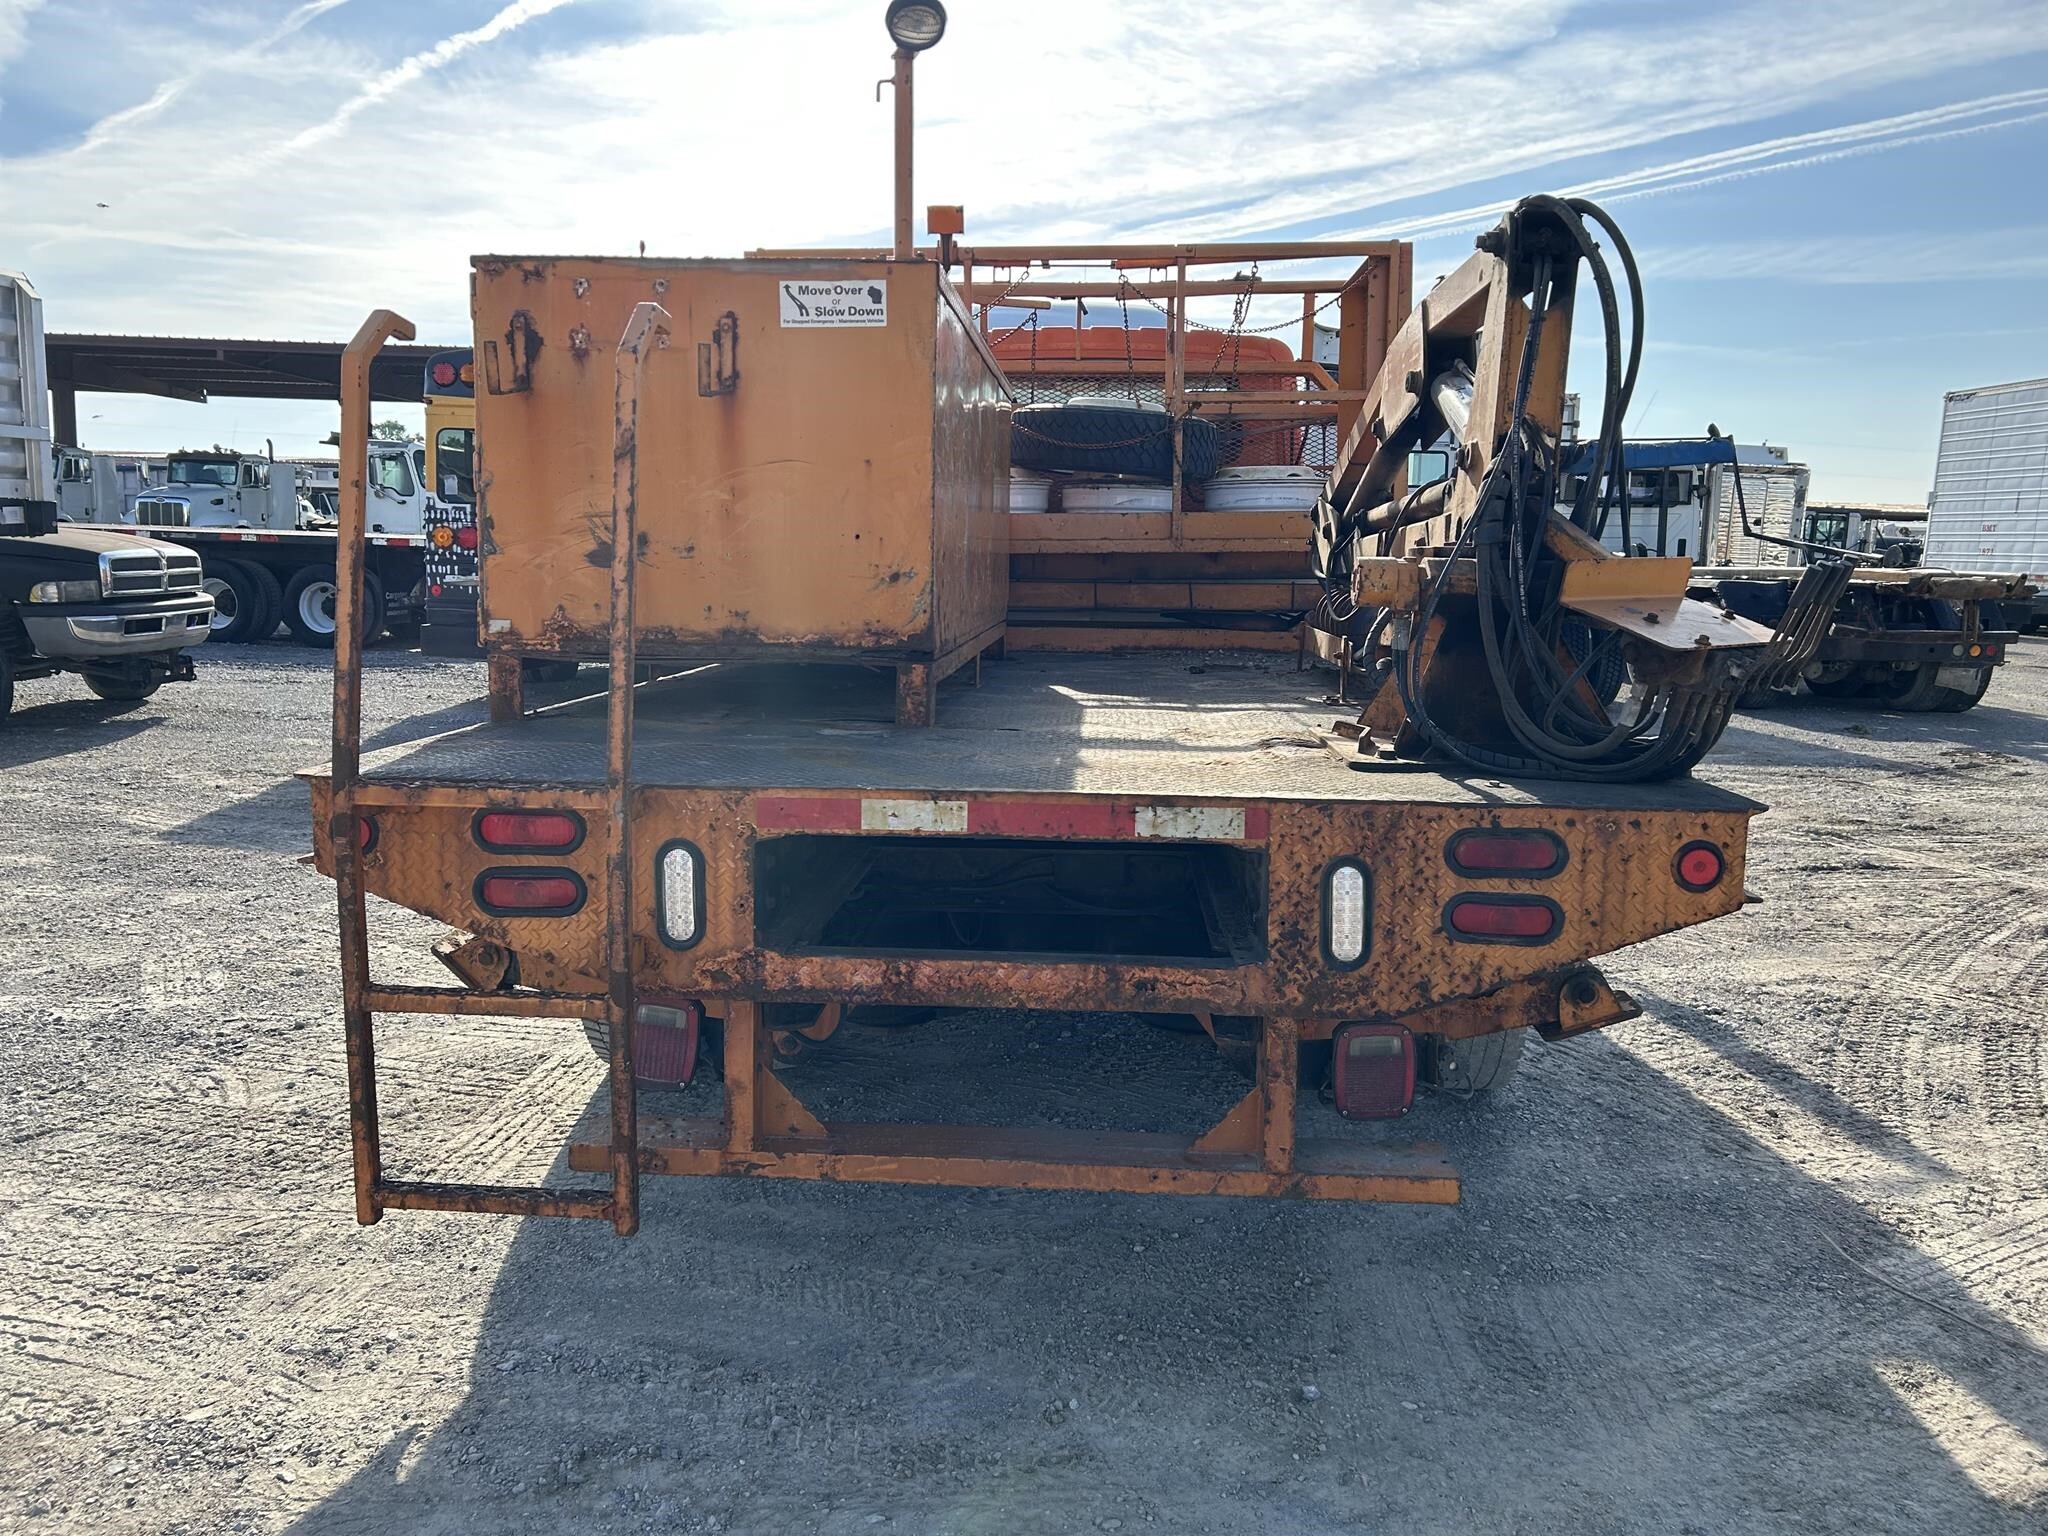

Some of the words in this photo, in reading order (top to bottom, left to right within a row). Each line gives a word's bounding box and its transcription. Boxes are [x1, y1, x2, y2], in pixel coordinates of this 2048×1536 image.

[798, 285, 832, 295] Move
[833, 285, 863, 295] Over
[815, 306, 845, 317] Slow
[848, 306, 884, 316] Down
